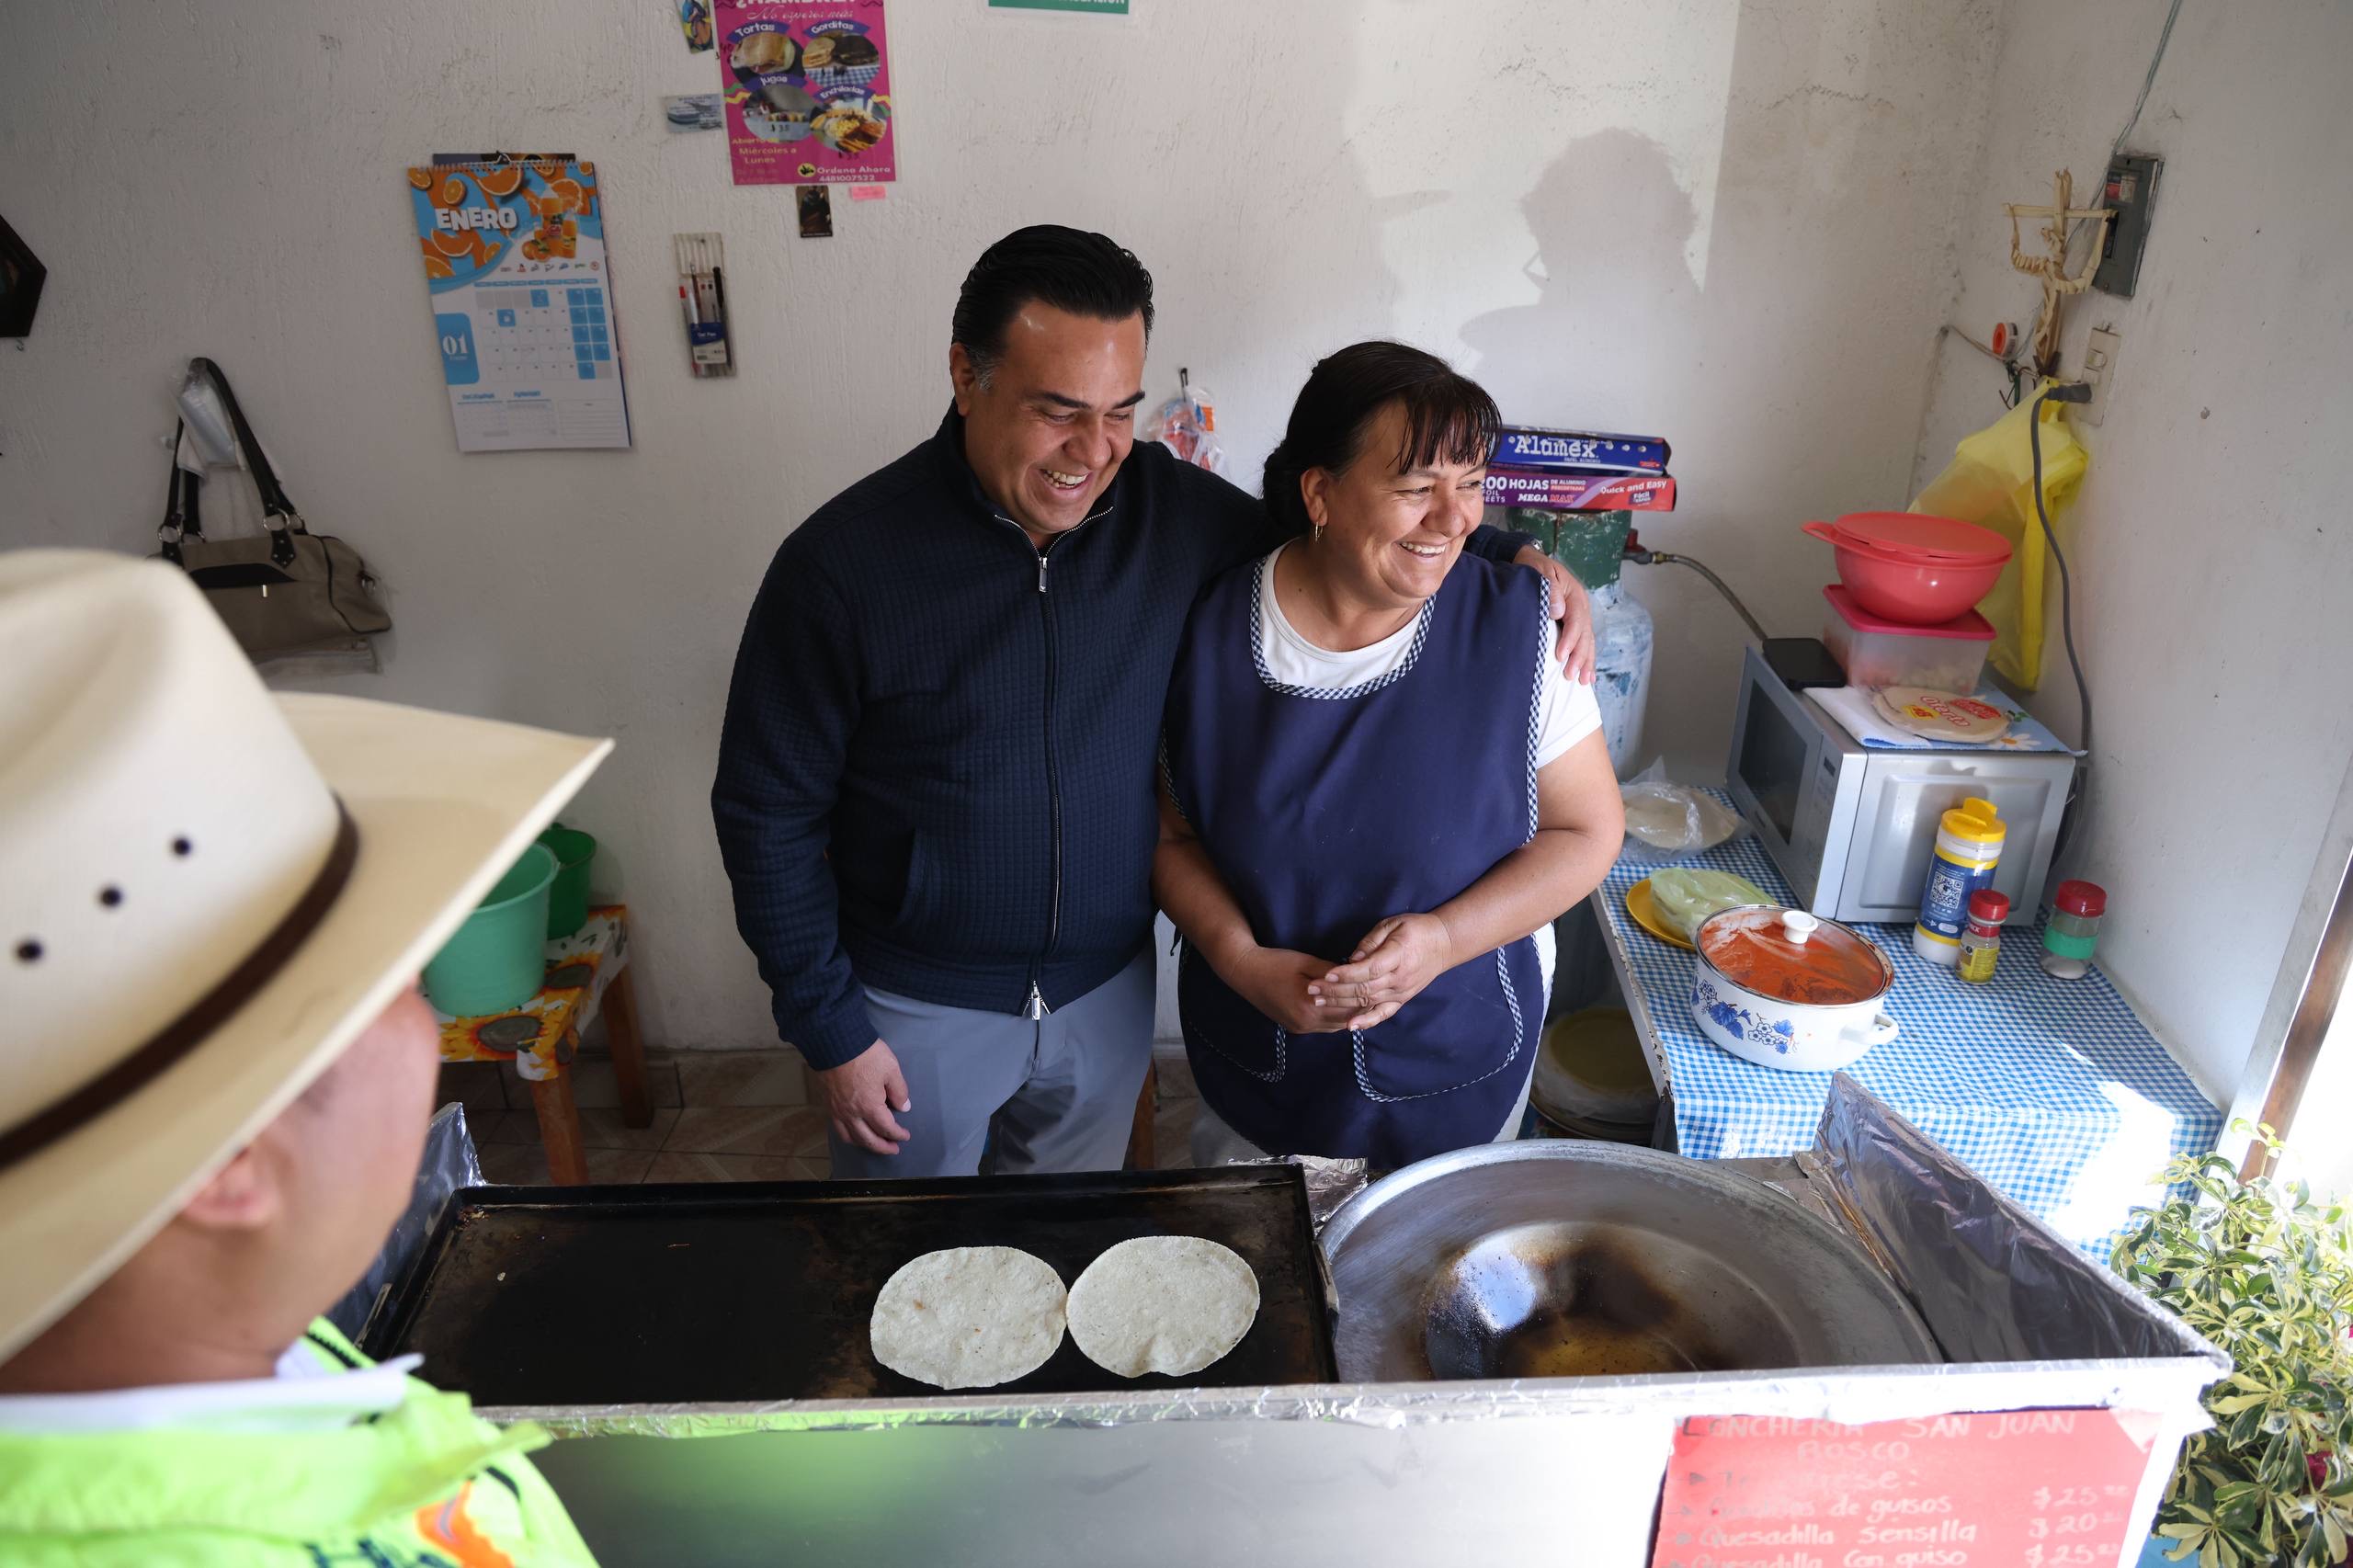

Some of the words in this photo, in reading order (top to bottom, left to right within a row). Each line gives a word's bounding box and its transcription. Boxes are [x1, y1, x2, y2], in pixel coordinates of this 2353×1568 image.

[735, 22, 775, 37] Tortas
[811, 19, 854, 34] Gorditas
[760, 74, 788, 85] Jugos
[820, 85, 865, 98] Enchiladas
[739, 147, 789, 155] Miércoles
[435, 207, 517, 231] ENERO
[442, 334, 468, 355] 01
[1515, 435, 1597, 458] Alumex
[1509, 479, 1550, 491] HOJAS
[1601, 484, 1626, 495] Quick
[1627, 483, 1645, 493] and
[1646, 480, 1667, 490] Easy
[1518, 494, 1549, 503] MEGA
[1900, 1415, 1972, 1439] SAN
[1985, 1412, 2077, 1440] JUAN
[1797, 1440, 1911, 1462] BOSCO
[1830, 1494, 1859, 1517] de
[1867, 1495, 1952, 1524] guisos
[1699, 1524, 1835, 1548] Quesadilla
